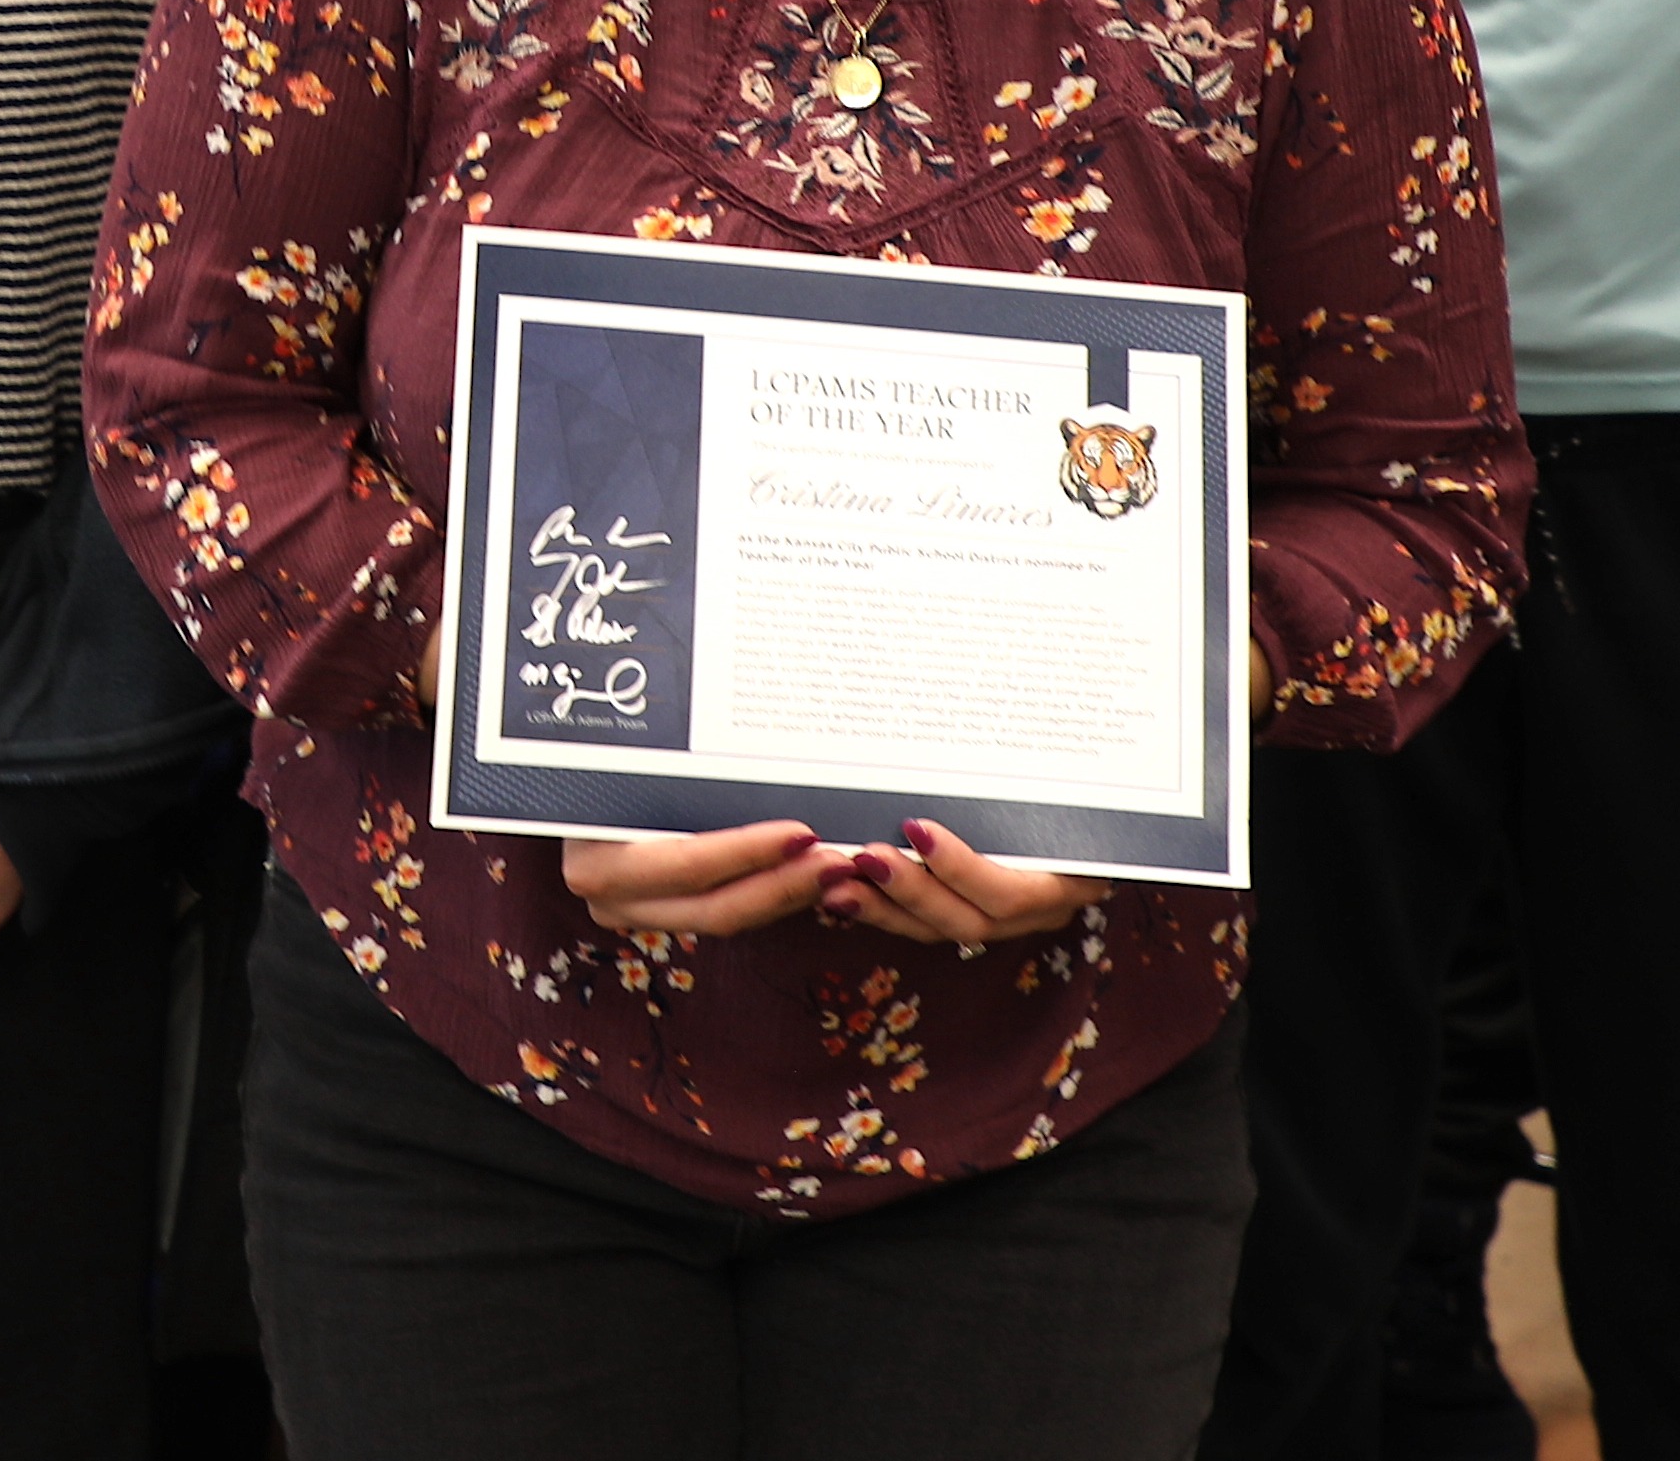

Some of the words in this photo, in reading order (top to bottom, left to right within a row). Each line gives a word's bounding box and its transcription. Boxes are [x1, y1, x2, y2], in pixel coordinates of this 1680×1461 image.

[752, 368, 877, 402] LCPAMS
[886, 380, 1032, 415] TEACHER
[750, 401, 791, 425] OF
[801, 405, 865, 433] THE
[875, 411, 954, 440] YEAR
[749, 471, 893, 514] Cristina
[906, 485, 1053, 527] Linares
